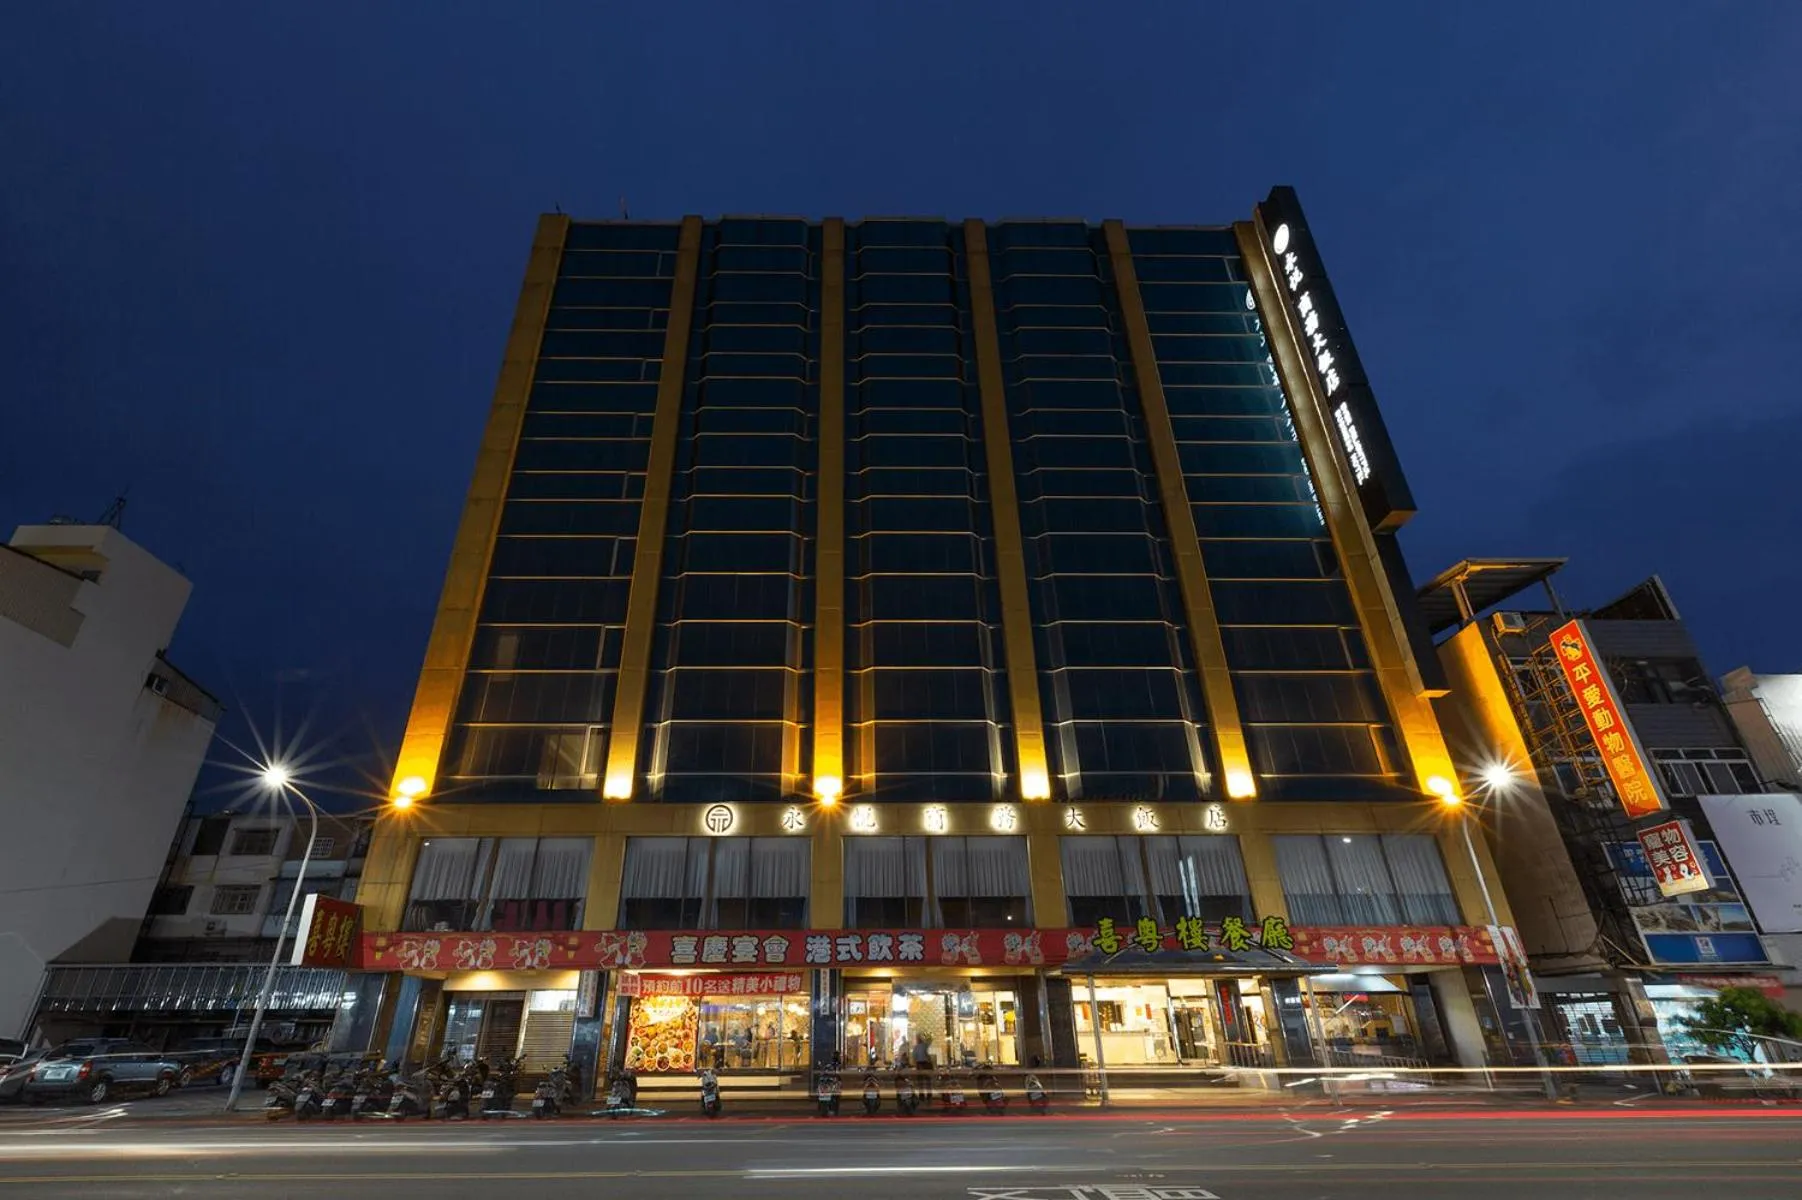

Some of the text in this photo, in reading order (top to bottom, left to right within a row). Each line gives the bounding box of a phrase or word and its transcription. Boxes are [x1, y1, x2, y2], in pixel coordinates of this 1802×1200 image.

[1642, 828, 1681, 850] 寵物
[1651, 844, 1689, 867] 美容
[671, 934, 924, 964] 喜慶宴會 港式飲茶
